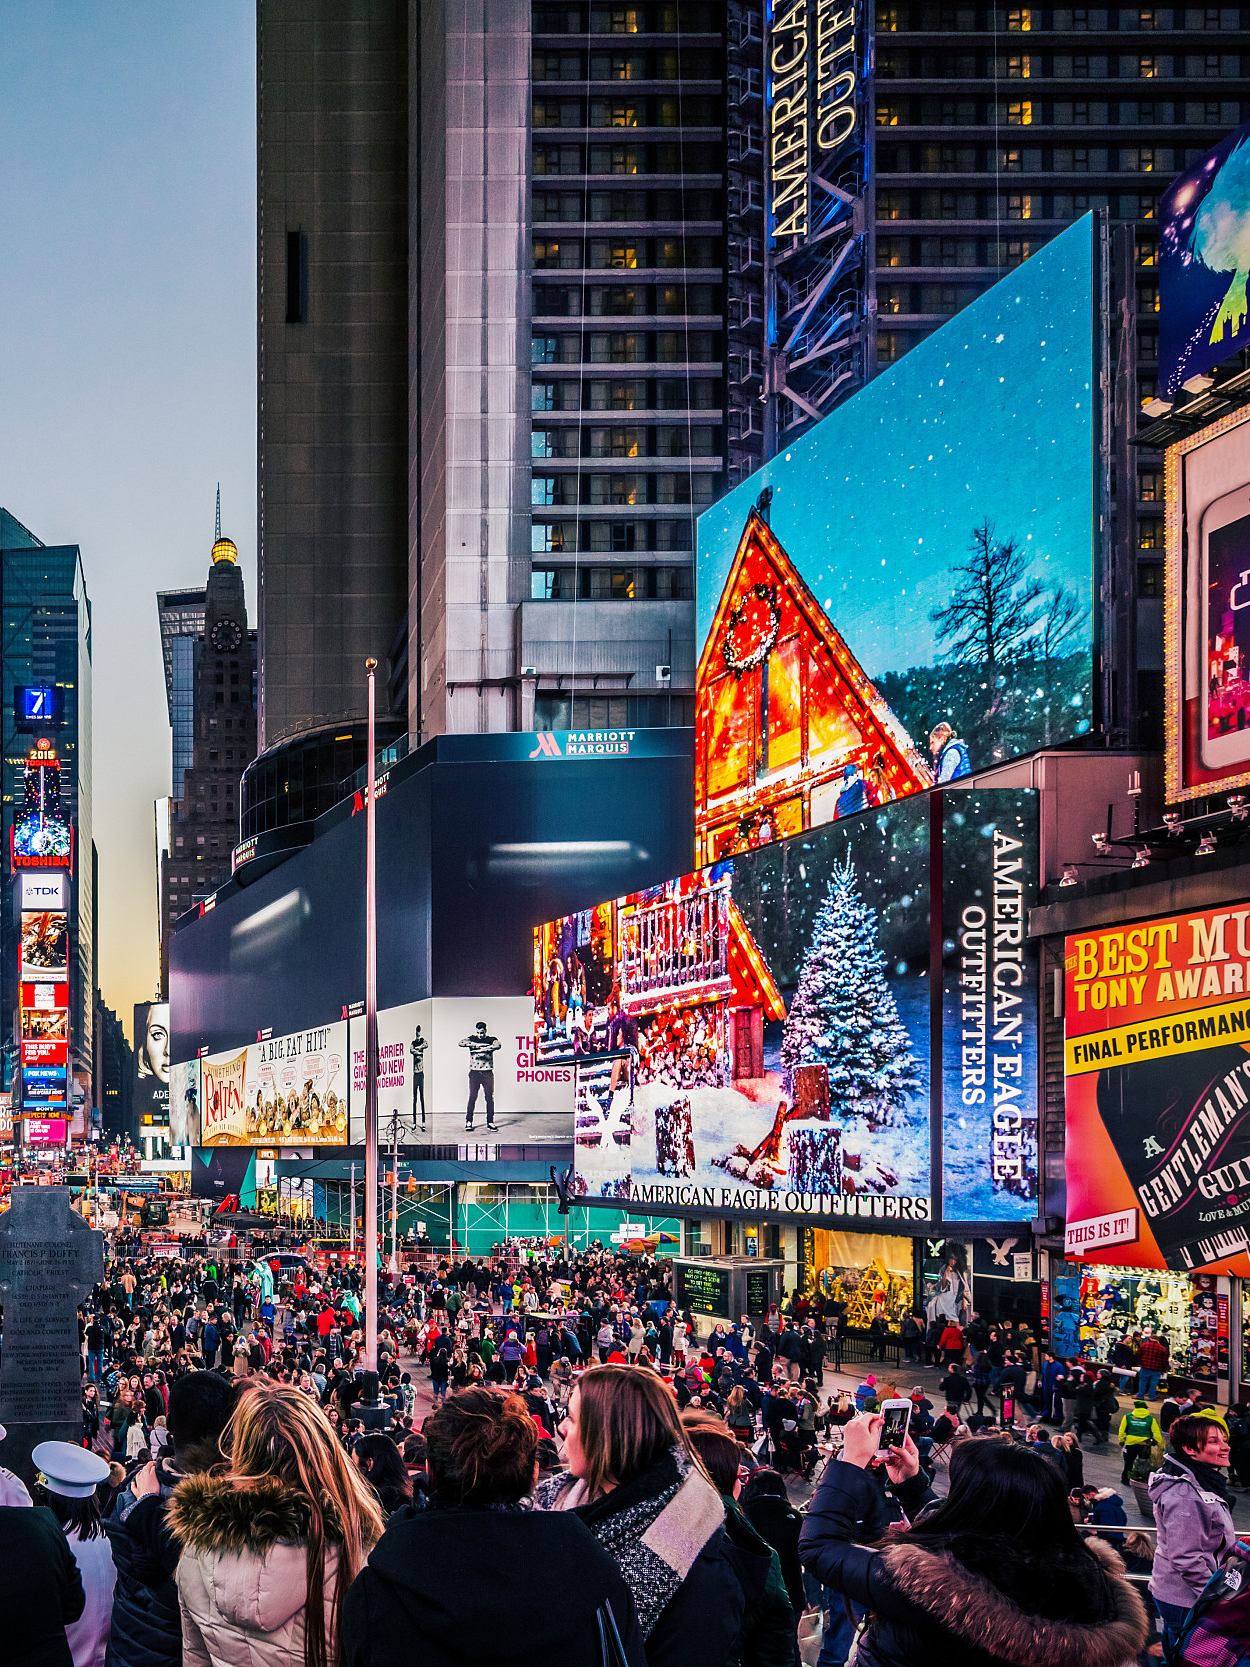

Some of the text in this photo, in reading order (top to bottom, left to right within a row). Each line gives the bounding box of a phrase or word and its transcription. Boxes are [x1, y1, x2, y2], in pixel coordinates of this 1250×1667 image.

[771, 0, 808, 237] AMERICA
[568, 732, 636, 743] MARRIOTT
[30, 751, 54, 759] 2015
[568, 744, 627, 755] MARQUIS
[15, 857, 70, 866] TOSHIBA
[33, 887, 59, 896] TDK
[1074, 922, 1178, 982] BEST
[1074, 961, 1250, 1012] TONY AWAR
[961, 905, 987, 1106] OUTFITTERS
[993, 829, 1024, 1180] AMERICAN EAGLE
[286, 1035, 302, 1057] FAT
[1073, 1037, 1122, 1065] FINAL
[353, 1050, 365, 1064] THE
[388, 1058, 405, 1074] NEW
[207, 1059, 241, 1079] SOMETHING
[516, 1070, 571, 1083] PHONES
[381, 1075, 405, 1088] DEMAND
[1142, 1135, 1165, 1159] A
[632, 1185, 929, 1221] AMERICAN EAGLE OUTFITTERS
[1198, 1209, 1234, 1223] LOVE &
[1067, 1217, 1130, 1245] THIS IS IT!
[2, 1250, 80, 1258] FRANCIS DUFFY
